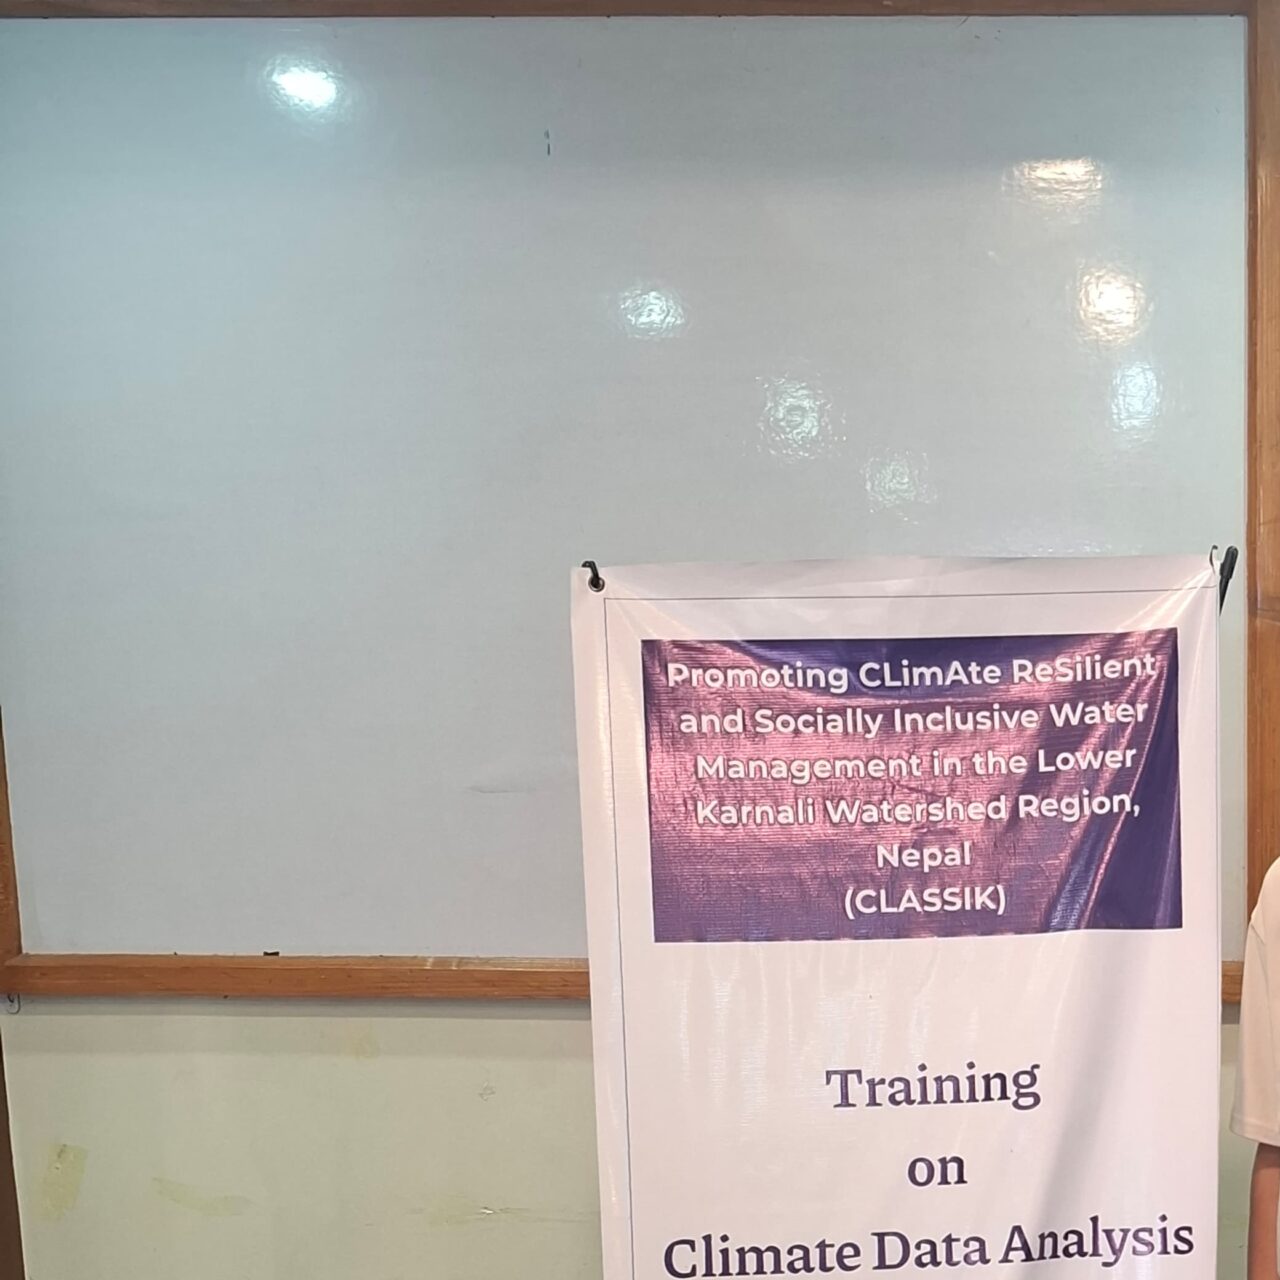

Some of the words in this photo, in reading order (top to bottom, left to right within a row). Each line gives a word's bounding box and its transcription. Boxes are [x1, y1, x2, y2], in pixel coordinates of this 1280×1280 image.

[667, 661, 849, 694] Promoting
[858, 659, 1001, 690] CLimAte
[1012, 653, 1157, 686] ReSilient
[679, 706, 744, 735] and
[754, 706, 882, 739] Socially
[894, 704, 1039, 733] Inclusive
[1050, 699, 1148, 729] Water
[696, 753, 922, 785] Management
[933, 751, 962, 777] in
[972, 749, 1027, 776] the
[1038, 746, 1137, 774] Lower
[696, 798, 816, 826] Karnali
[826, 794, 1007, 825] Watershed
[1018, 789, 1141, 824] Region,
[876, 843, 971, 874] Nepal
[844, 884, 1008, 920] (CLASSIK)
[825, 1061, 1042, 1112] Training
[907, 1153, 968, 1187] on
[664, 1233, 862, 1279] Climate
[871, 1229, 991, 1271] Data
[999, 1214, 1195, 1269] Analysis
